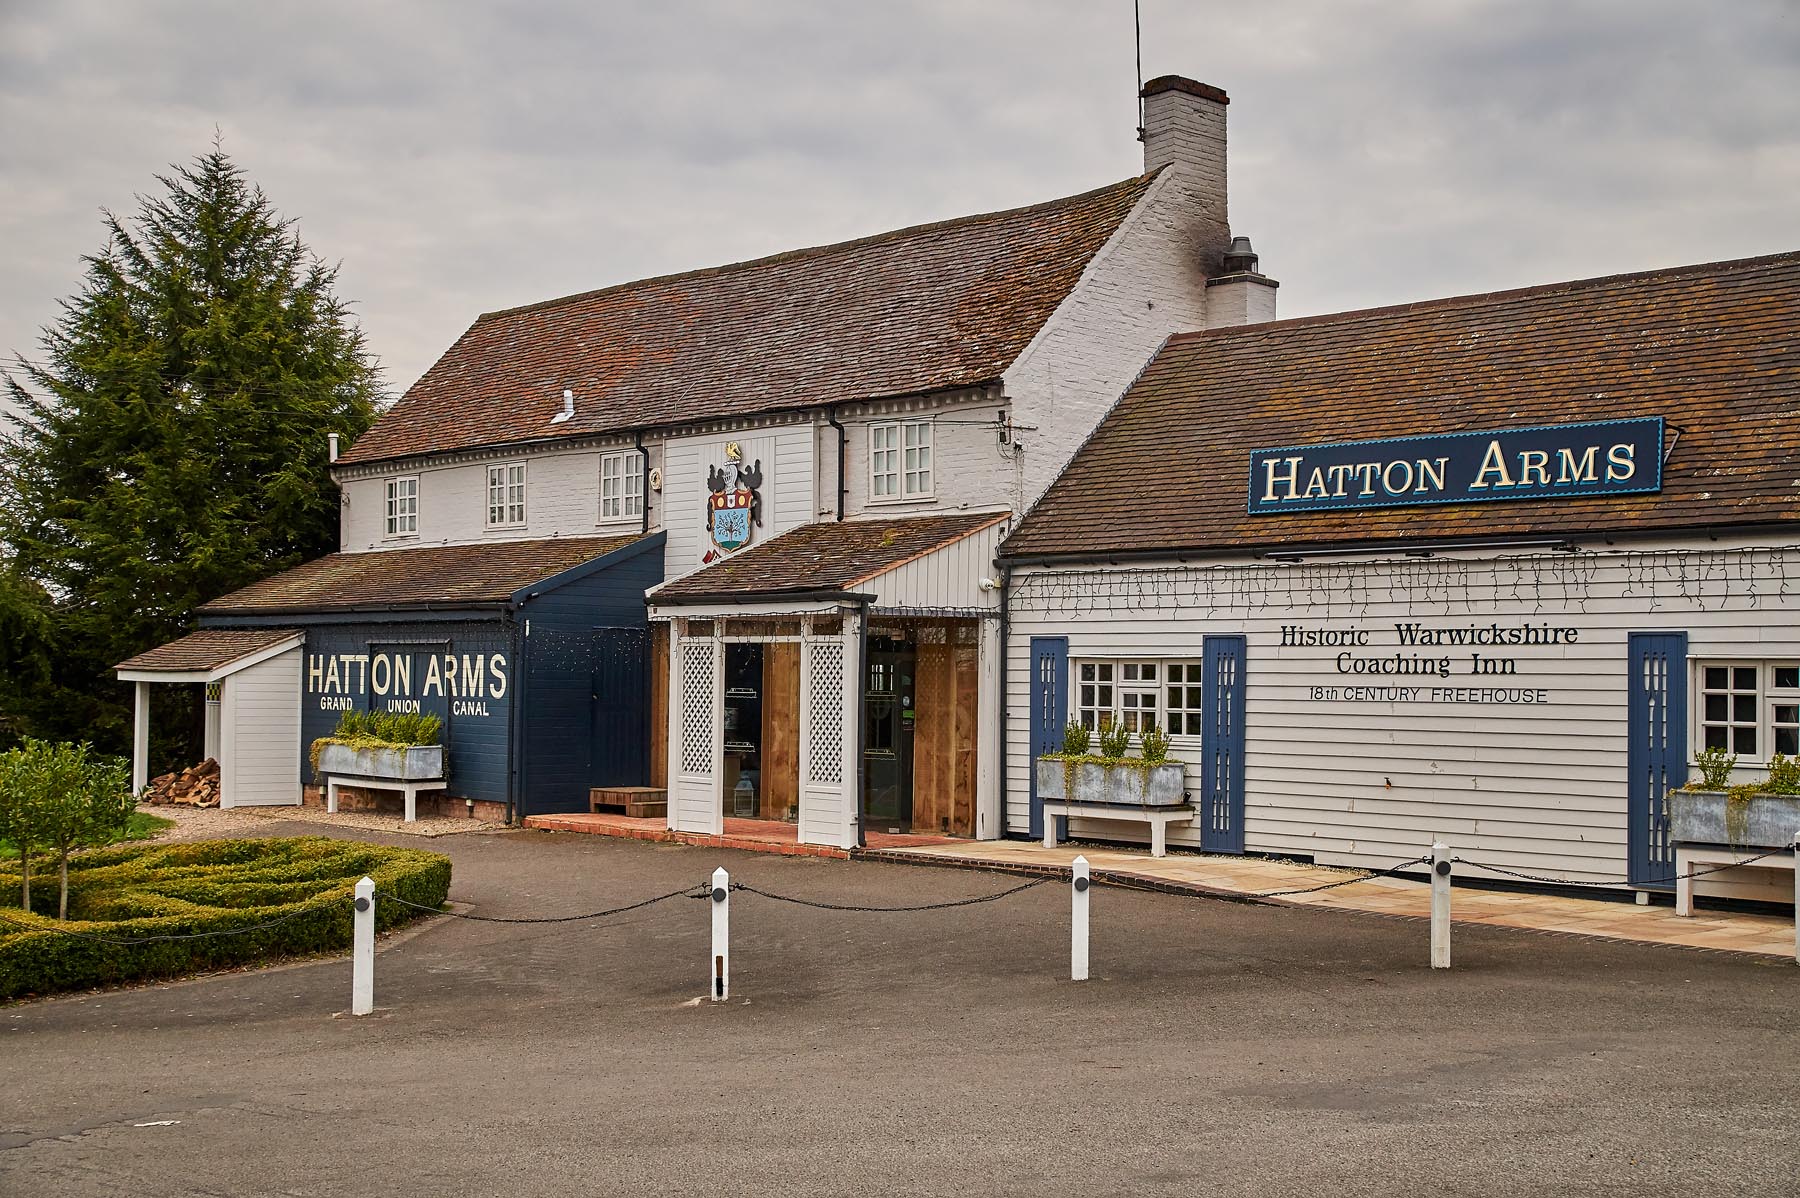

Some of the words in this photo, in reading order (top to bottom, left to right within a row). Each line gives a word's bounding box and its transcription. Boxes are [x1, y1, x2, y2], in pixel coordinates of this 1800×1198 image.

[1260, 457, 1449, 504] HATTON
[1468, 440, 1636, 492] ARMS
[1280, 625, 1369, 646] Historic
[1395, 623, 1578, 645] Warwickshire
[308, 654, 411, 696] HATTON
[422, 653, 507, 699] ARMS
[1337, 652, 1450, 678] Coaching
[1471, 653, 1517, 674] Inn
[320, 696, 353, 711] GRAND
[387, 699, 421, 714] UNION
[453, 701, 490, 717] CANAL
[1309, 687, 1338, 700] 18th
[1343, 687, 1420, 701] CENTURY
[1431, 688, 1548, 703] FREEHOUSE
